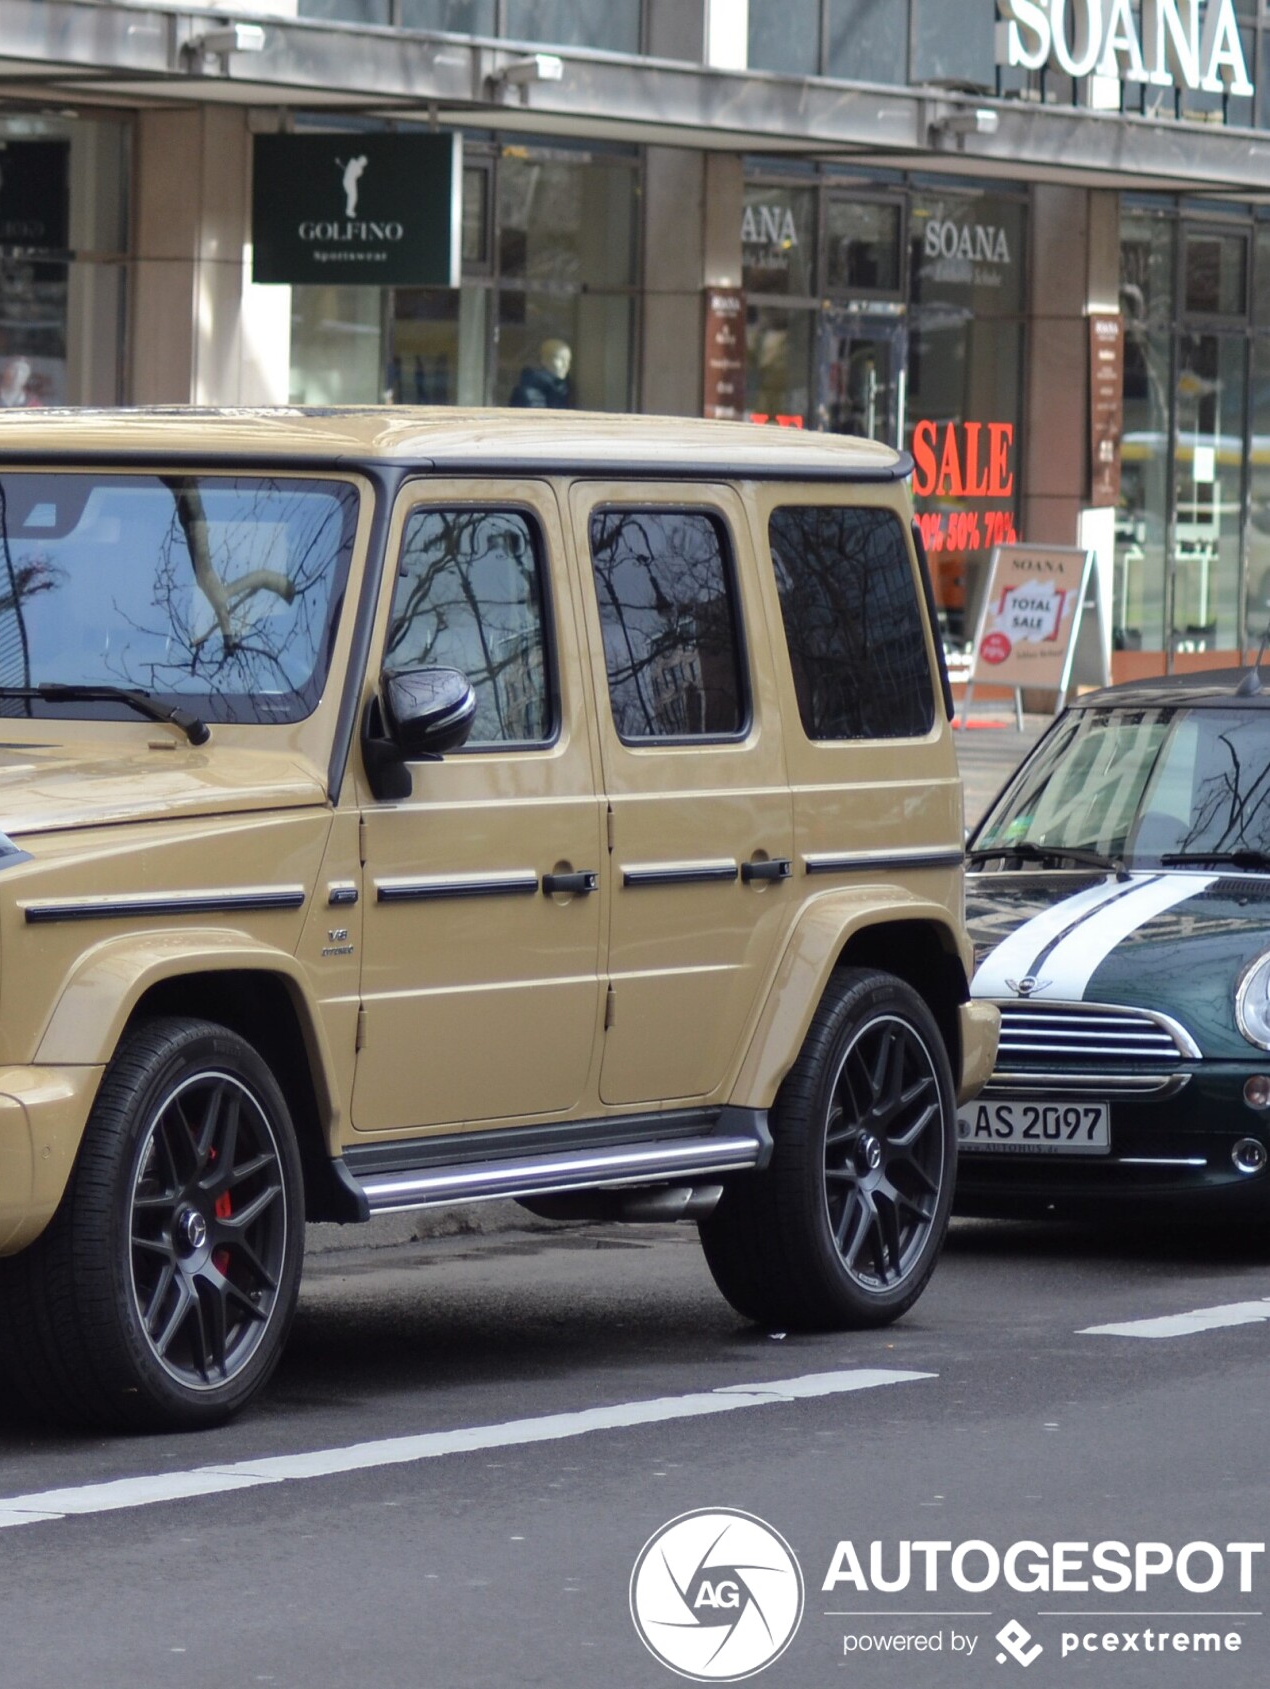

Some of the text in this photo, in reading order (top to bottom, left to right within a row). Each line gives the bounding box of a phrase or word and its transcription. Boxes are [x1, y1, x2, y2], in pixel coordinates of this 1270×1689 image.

[1008, 0, 1254, 97] SOANA
[298, 221, 404, 241] GOLFINO
[925, 221, 1010, 263] SOANA
[313, 250, 388, 262] Sportswear
[912, 419, 1013, 497] SALE
[946, 511, 980, 552] 50%
[983, 510, 1017, 549] 70%
[1012, 558, 1065, 574] SOANA
[1011, 598, 1051, 612] TOTAL
[1012, 617, 1043, 630] SALE
[974, 1105, 1102, 1140] AS 2097
